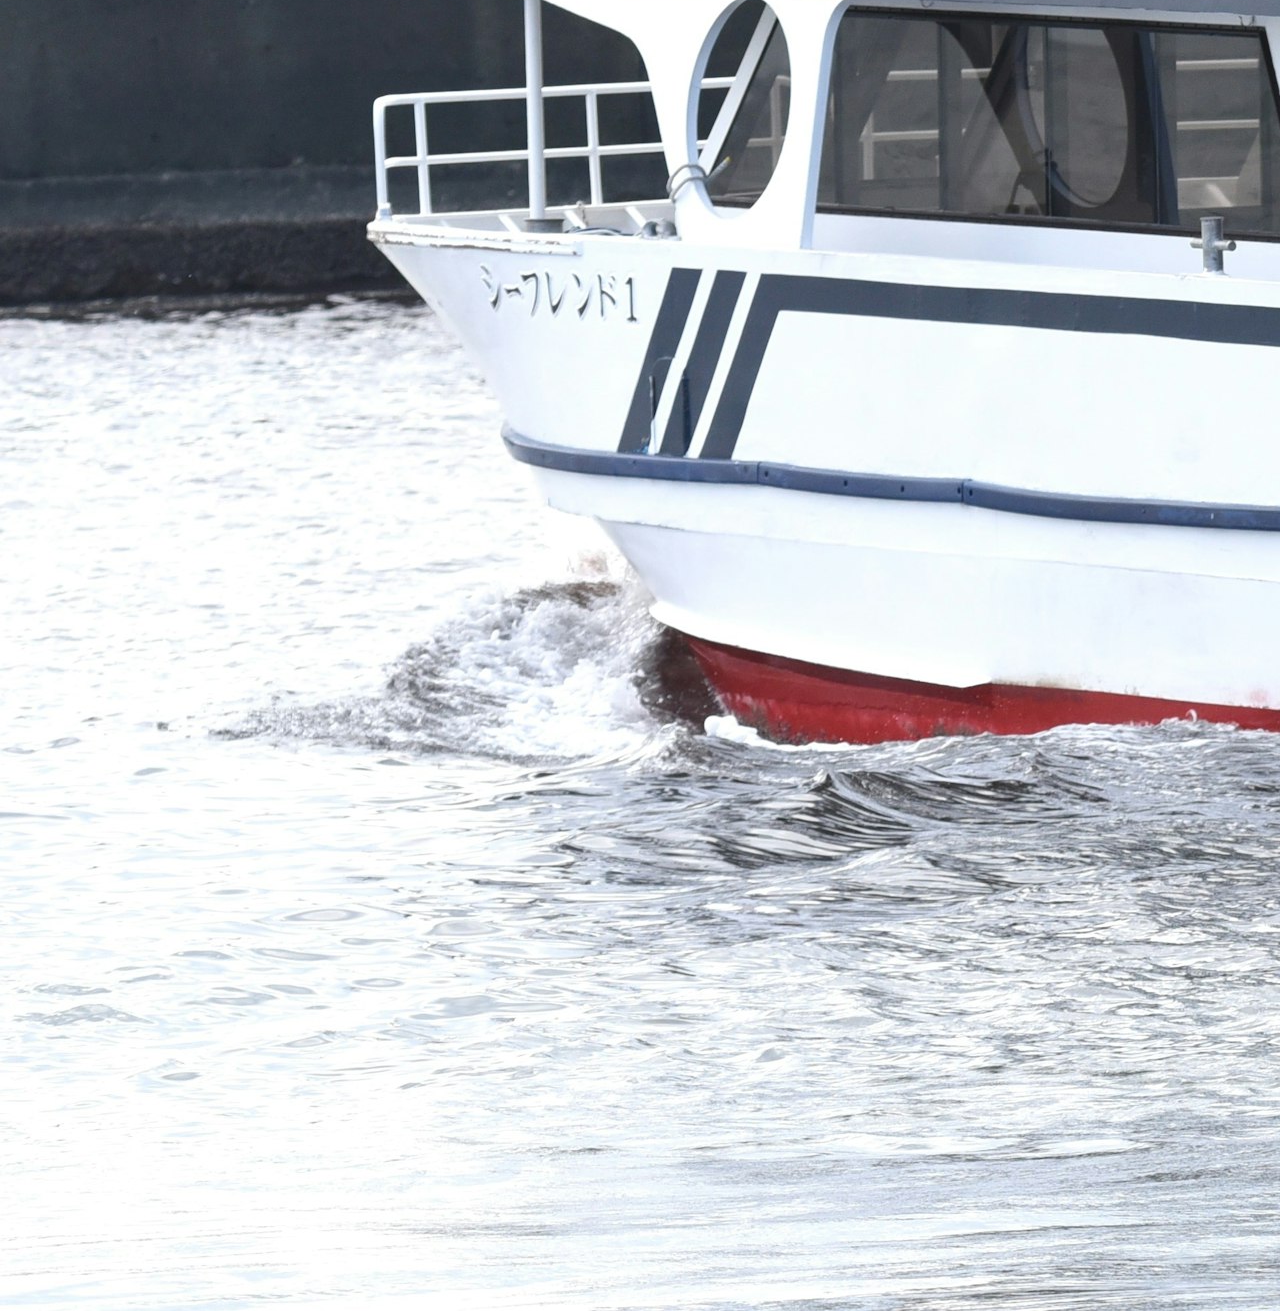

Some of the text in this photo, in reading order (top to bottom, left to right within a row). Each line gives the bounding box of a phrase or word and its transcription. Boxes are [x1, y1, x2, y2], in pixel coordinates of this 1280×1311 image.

[480, 265, 637, 324] シーフレンド1
